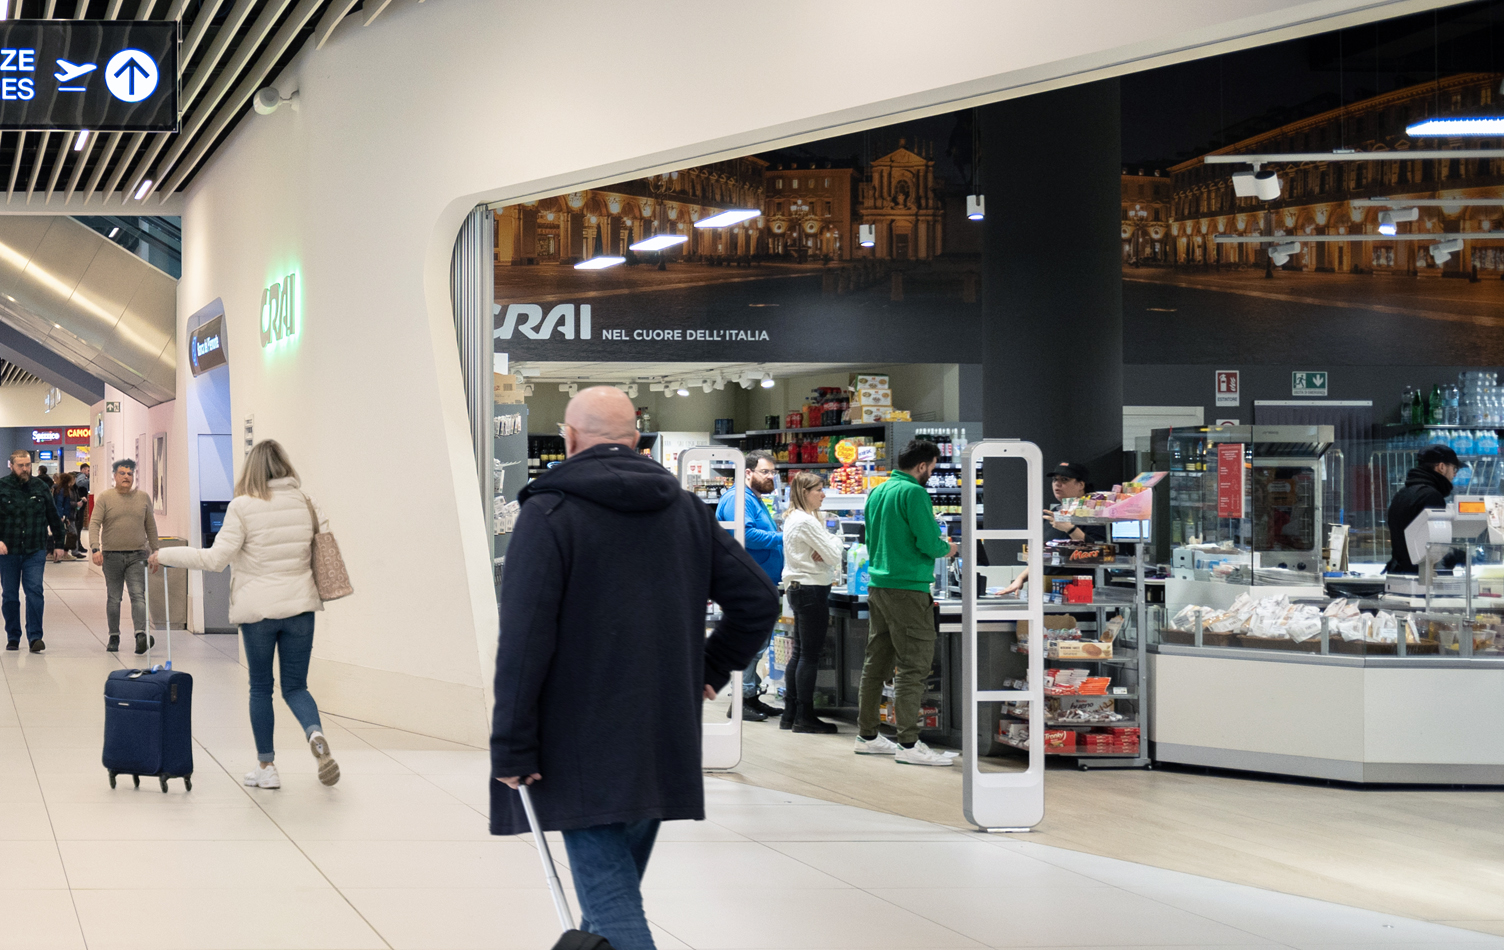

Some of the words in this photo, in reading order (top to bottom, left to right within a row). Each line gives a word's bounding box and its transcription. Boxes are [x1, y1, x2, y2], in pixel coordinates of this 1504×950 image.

[260, 273, 295, 348] CRAI
[602, 329, 630, 341] NEL
[633, 329, 682, 341] CUORE
[686, 329, 769, 341] DELL'ITALIA
[1069, 549, 1100, 560] Mars
